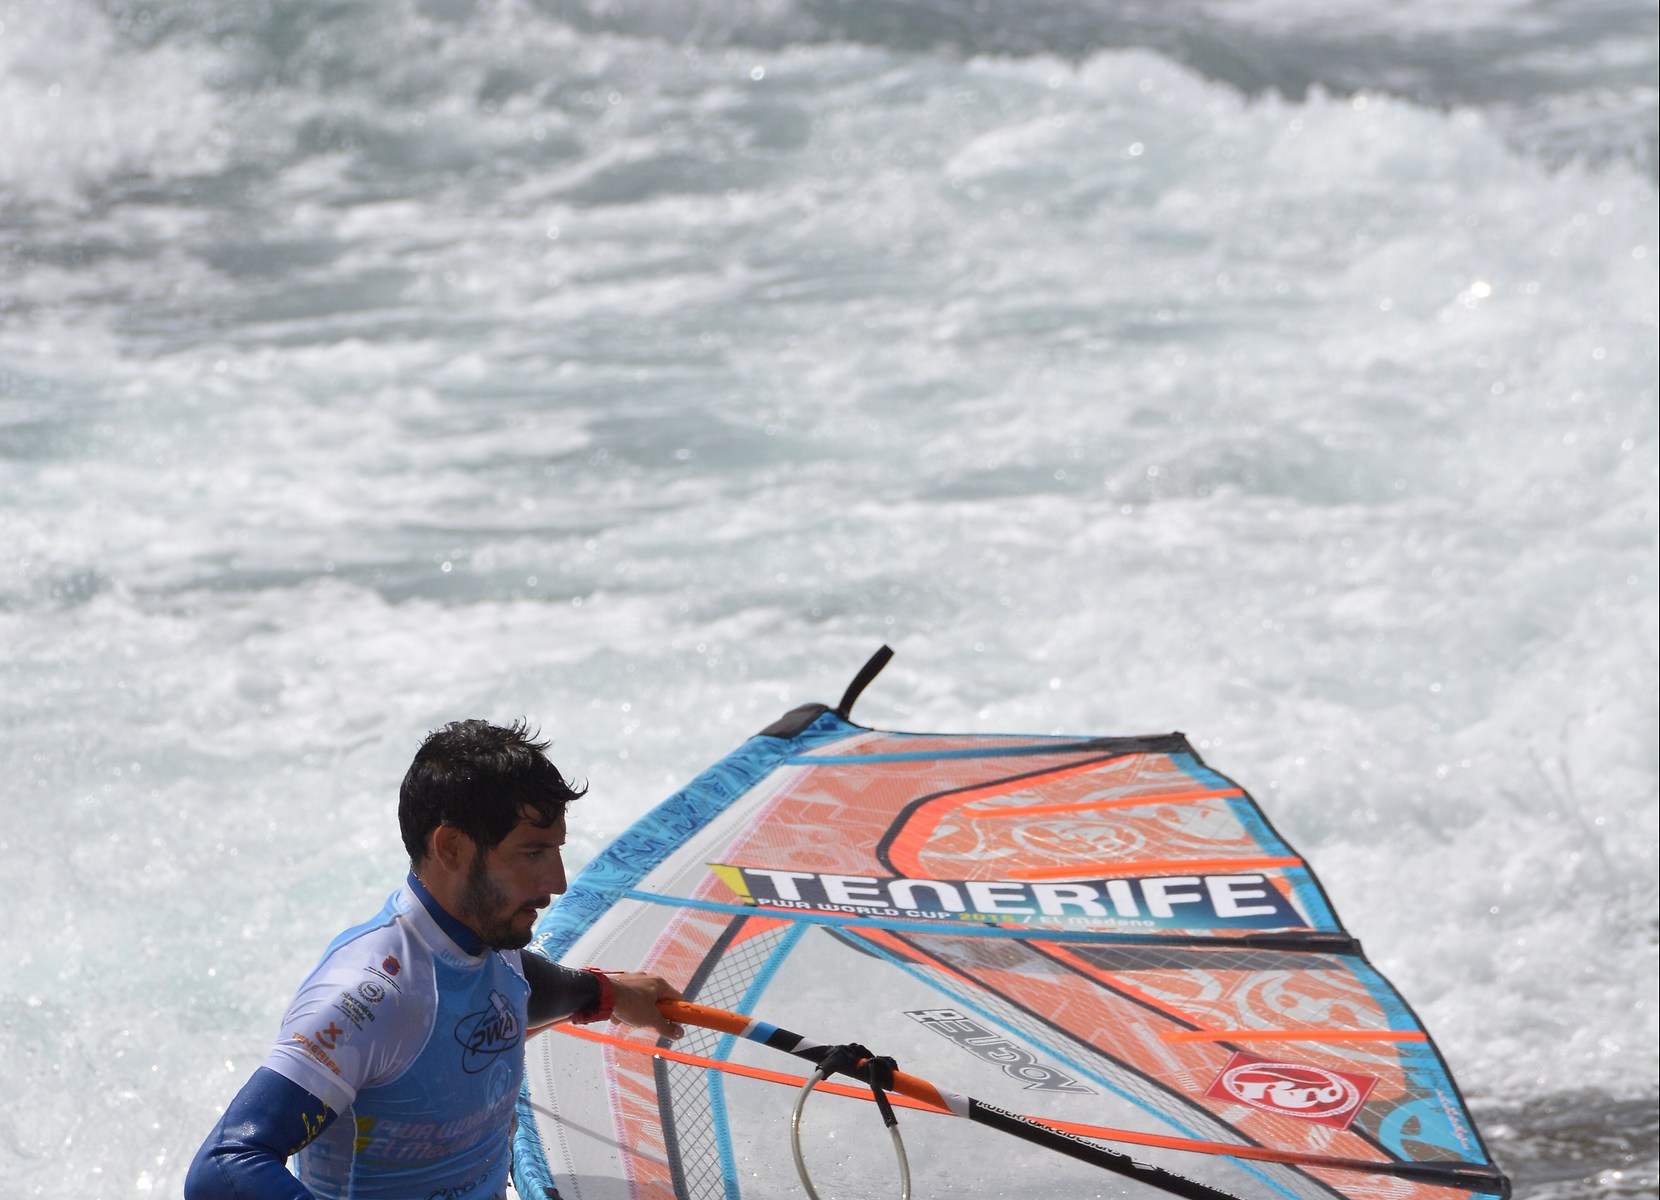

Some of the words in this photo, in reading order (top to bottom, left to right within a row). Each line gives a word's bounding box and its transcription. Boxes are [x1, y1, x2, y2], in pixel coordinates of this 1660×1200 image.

[743, 867, 1279, 919] TENERIFE
[757, 898, 811, 909] PWA
[817, 903, 899, 916] WORLD
[906, 909, 951, 919] CUP
